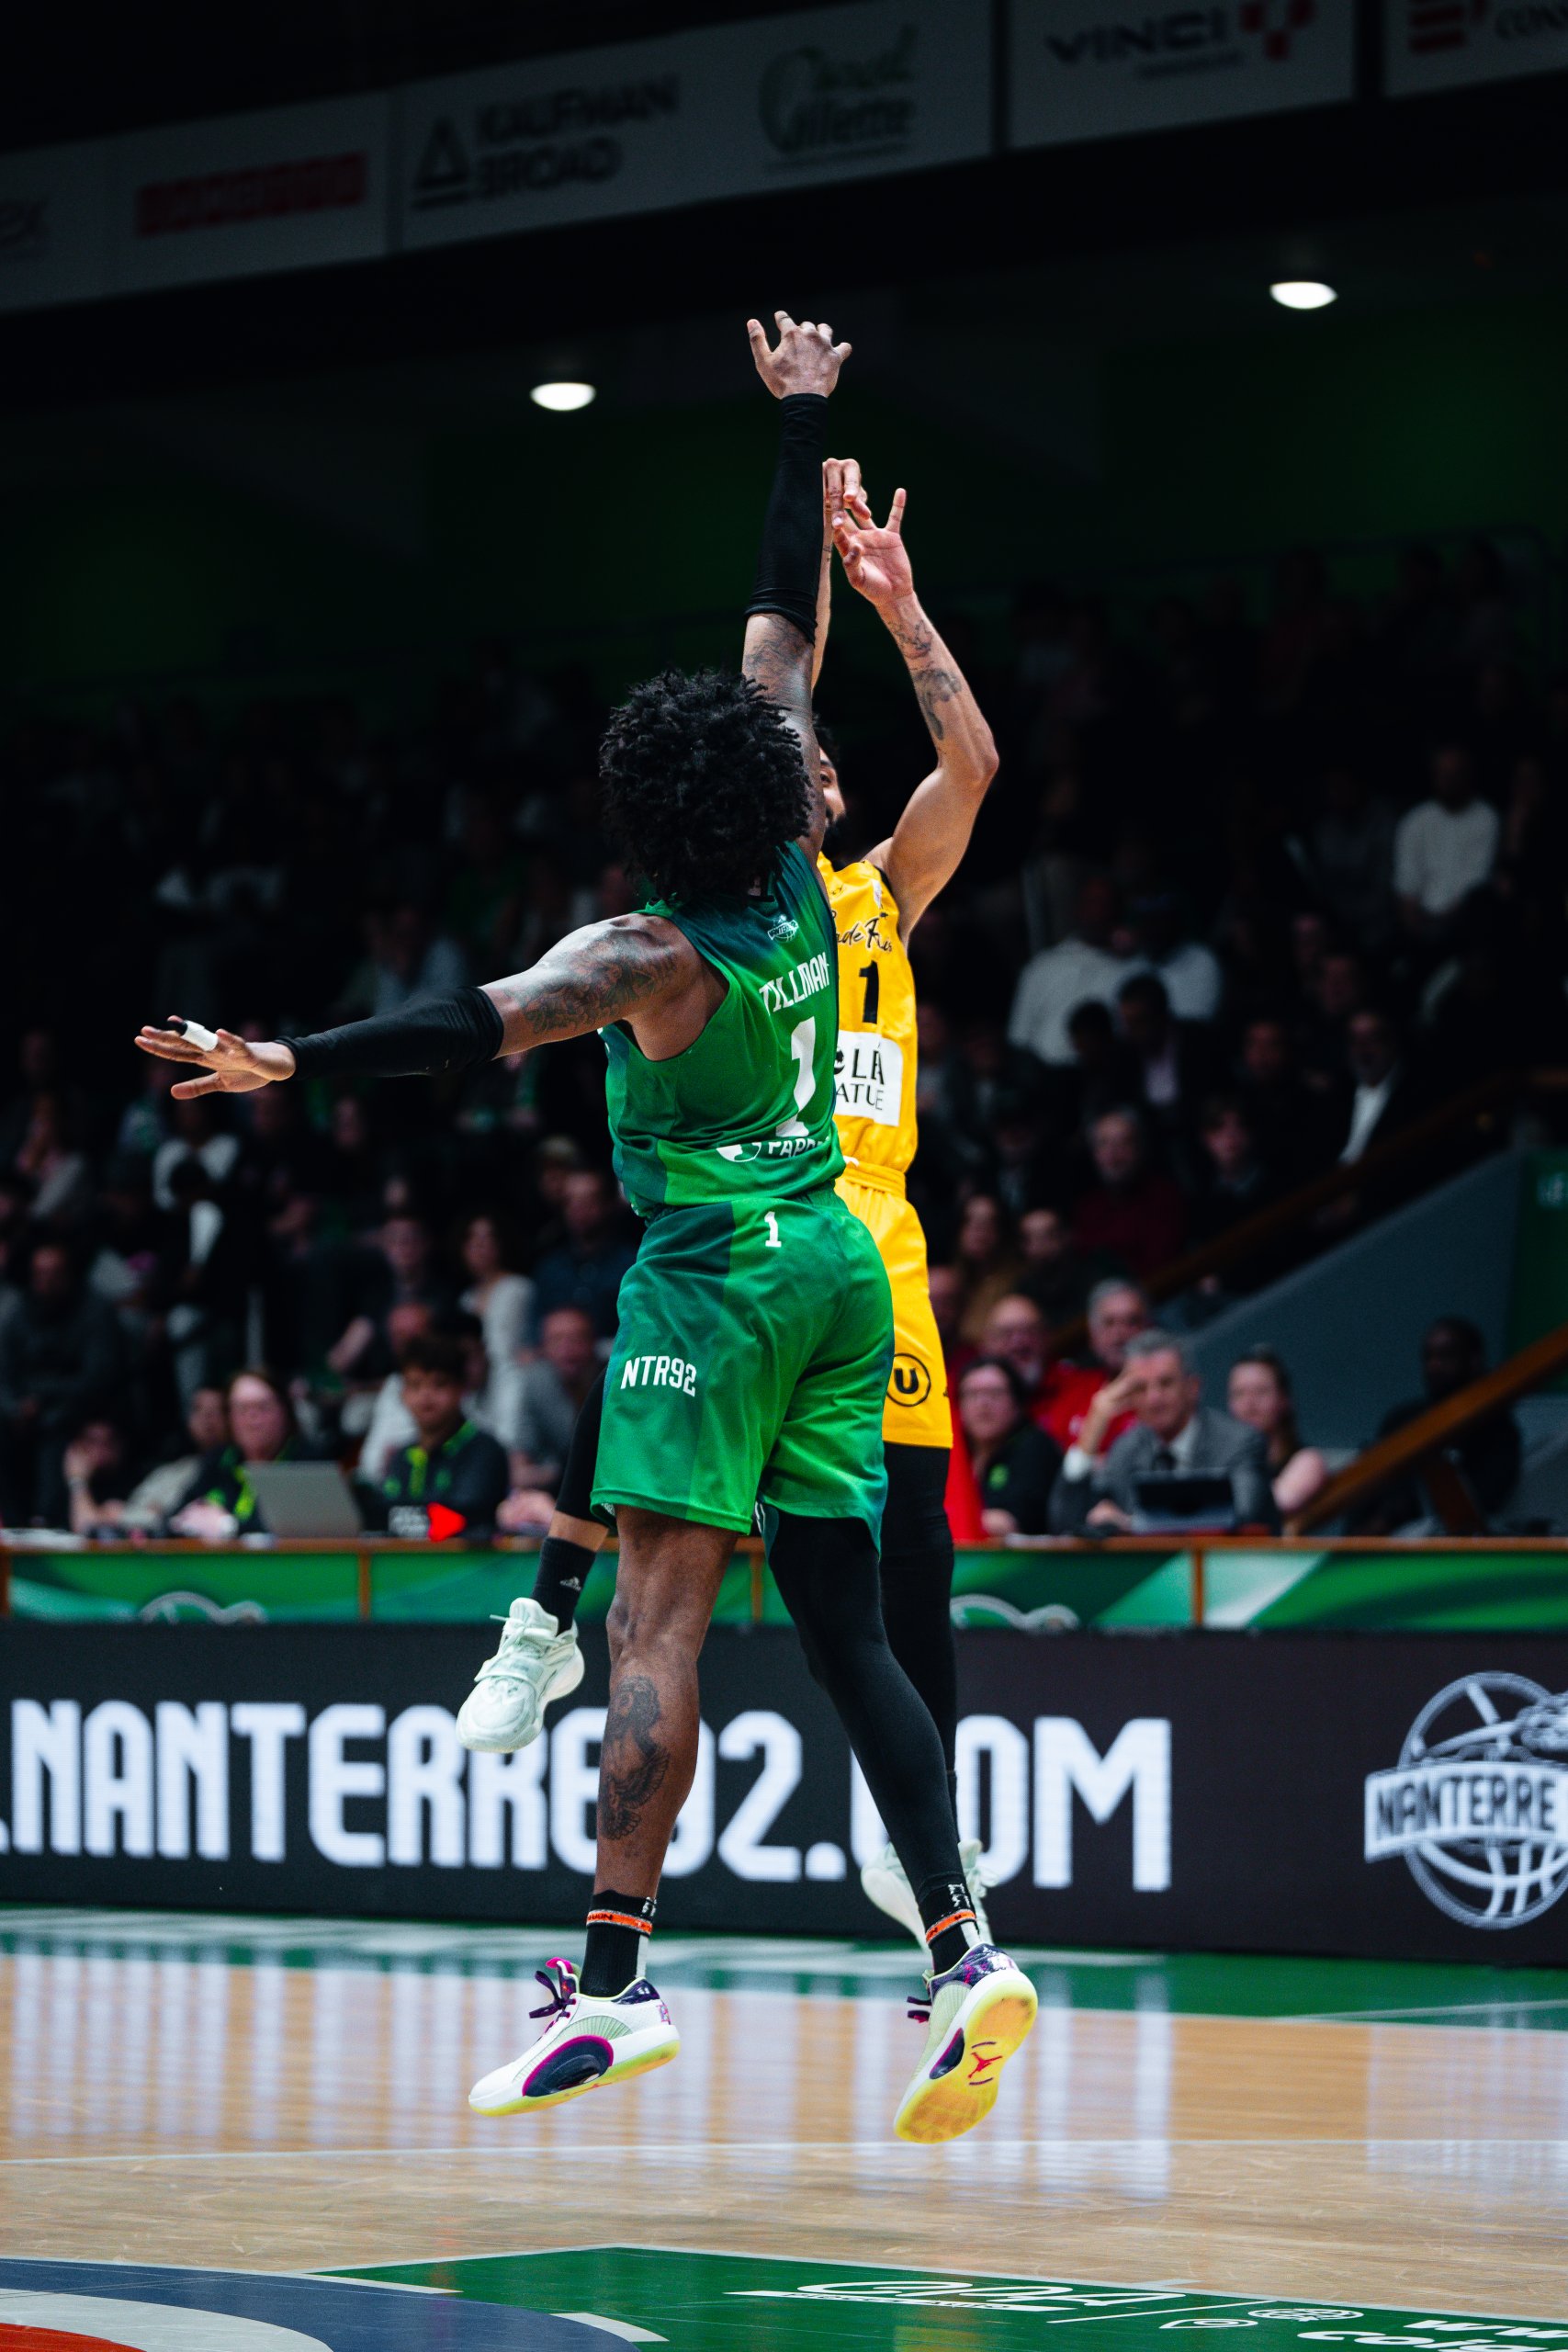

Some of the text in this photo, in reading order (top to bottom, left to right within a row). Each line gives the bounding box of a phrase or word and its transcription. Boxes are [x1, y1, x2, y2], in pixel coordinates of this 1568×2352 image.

[1045, 6, 1229, 65] VINCI
[759, 951, 830, 1017] TILLMAN
[859, 960, 879, 1024] 1
[775, 1016, 816, 1137] 1
[764, 1211, 783, 1248] 1
[620, 1355, 697, 1397] NTR92
[894, 1368, 919, 1395] U
[0, 1699, 1173, 1893] NANTERRE2.OM
[1377, 1775, 1557, 1838] NANTERRE
